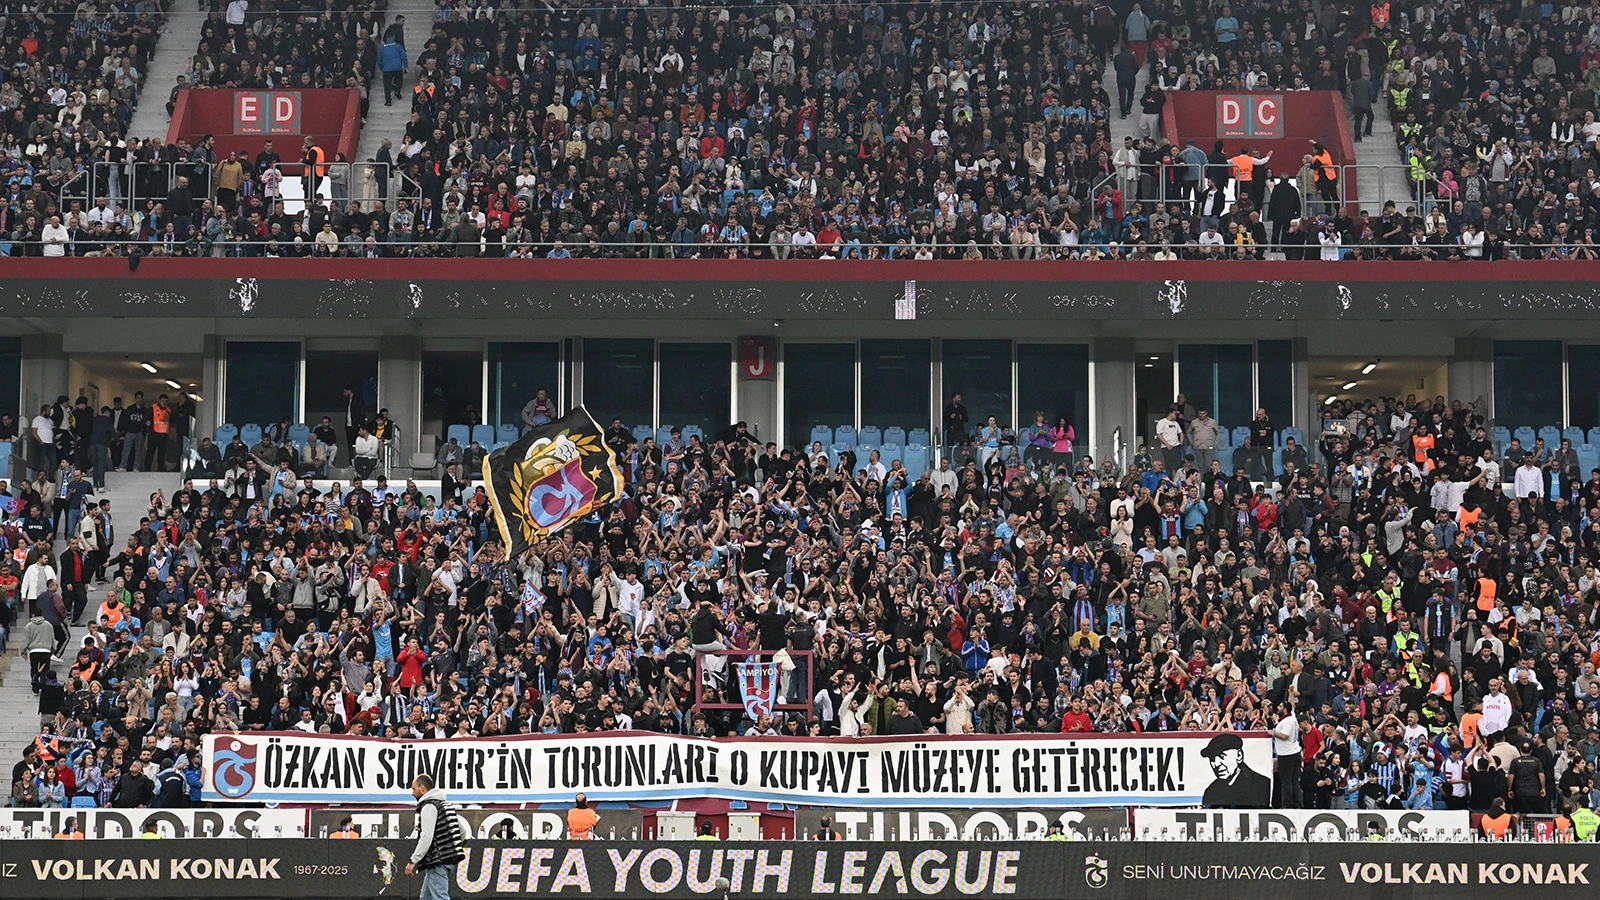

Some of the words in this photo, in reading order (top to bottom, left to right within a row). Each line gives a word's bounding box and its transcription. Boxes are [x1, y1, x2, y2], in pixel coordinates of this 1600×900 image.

[241, 97, 257, 121] E
[276, 97, 293, 121] D
[1223, 100, 1240, 124] D
[1258, 100, 1276, 124] C
[749, 346, 764, 376] J
[264, 737, 366, 790] ÖZKAN
[376, 743, 533, 790] SÜMER'İN
[731, 750, 748, 786] O
[760, 750, 870, 793] KUPAYI
[881, 743, 1001, 793] MÜZEYE
[1012, 741, 1186, 793] GETİRECEK!
[31, 858, 160, 880] VOLKAN
[171, 858, 281, 880] KONAK
[293, 865, 349, 875] 1967-2025
[453, 849, 592, 893] UEFA
[607, 849, 794, 894] YOUTH
[811, 850, 1021, 895] LEAGUE
[1123, 862, 1164, 880] SENİ
[1339, 862, 1469, 885] VOLKAN
[1479, 862, 1590, 885] KONAK
